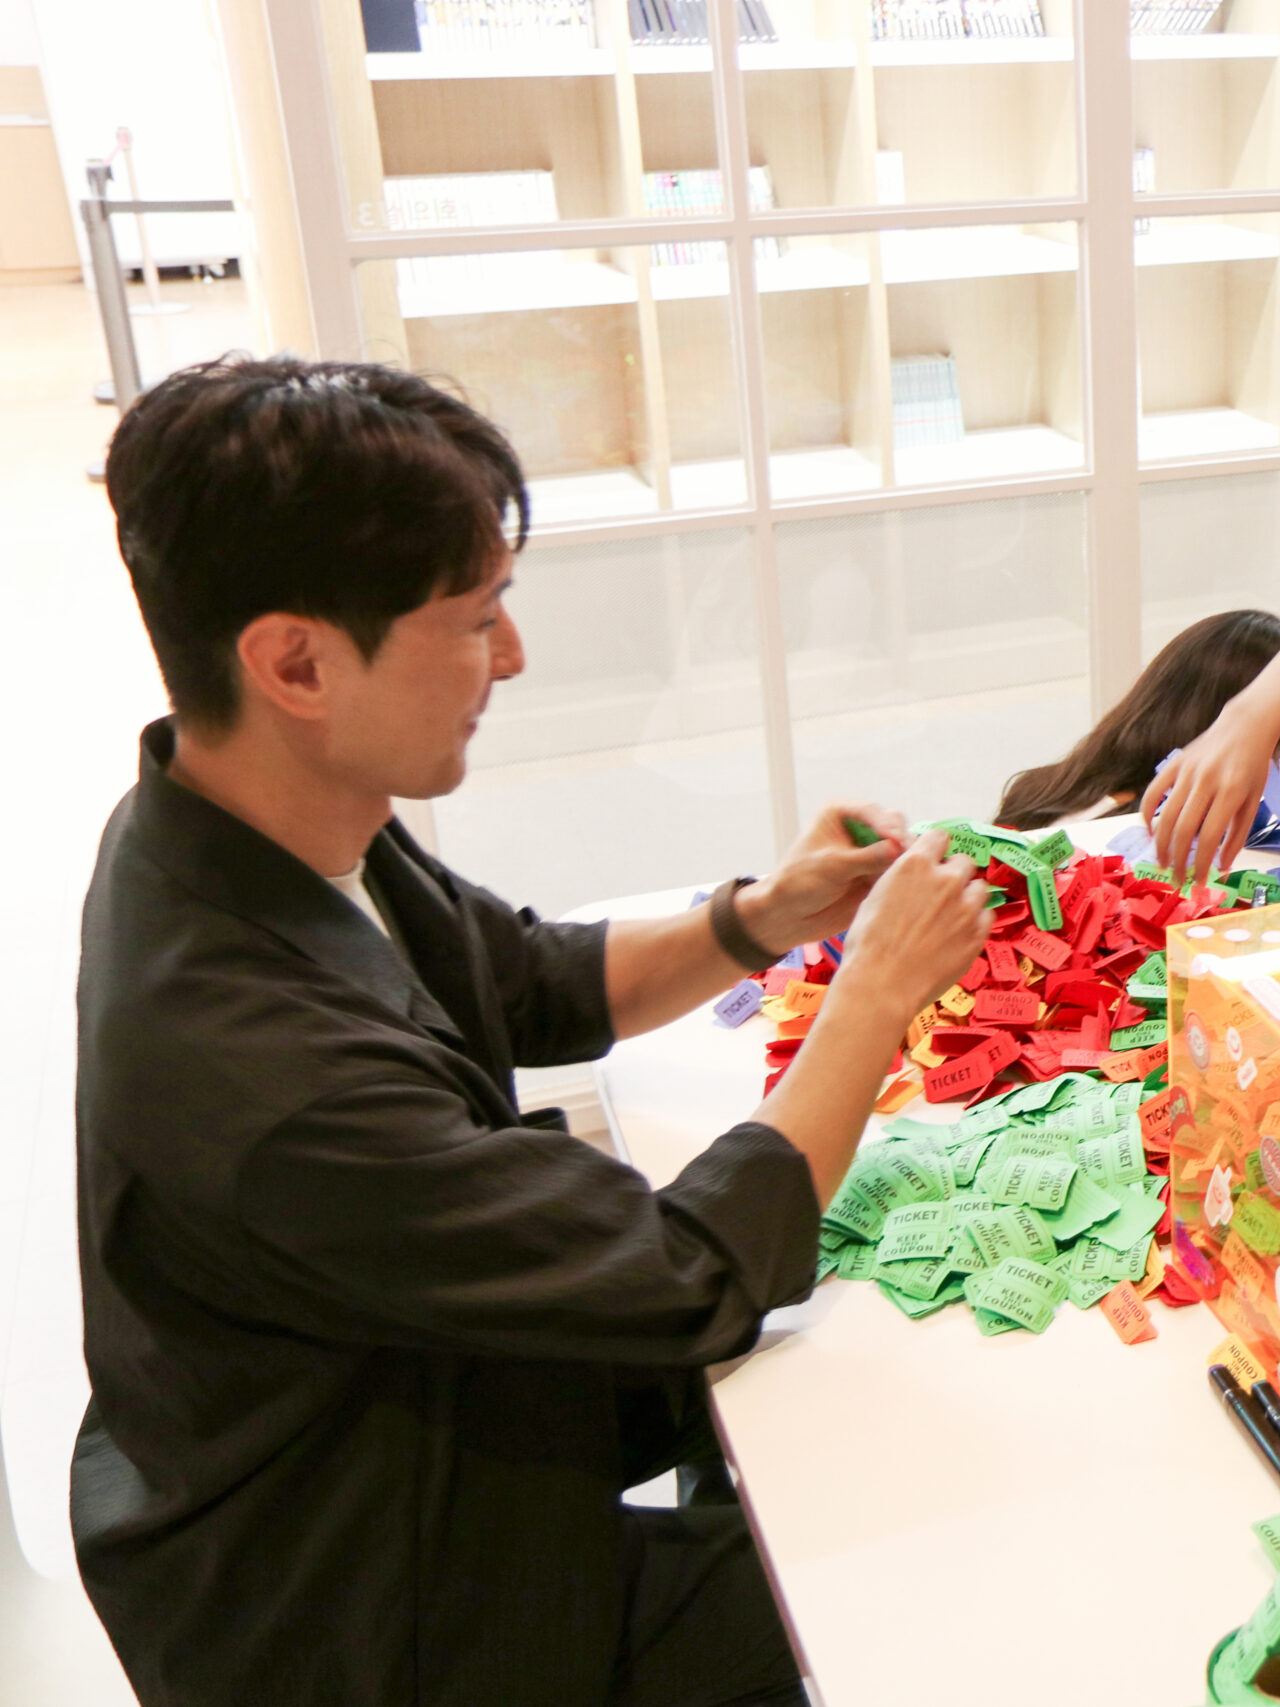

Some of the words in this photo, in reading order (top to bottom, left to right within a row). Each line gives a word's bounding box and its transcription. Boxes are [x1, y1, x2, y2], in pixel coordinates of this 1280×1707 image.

[1022, 931, 1056, 957] TICKET
[722, 990, 754, 1019] TICKET
[989, 993, 1033, 1005] COUPON
[1124, 1023, 1166, 1035] COUPON
[931, 1067, 972, 1092] TICKET
[1020, 1132, 1070, 1142] COUPON
[1117, 1134, 1134, 1169] TICKET
[874, 1176, 898, 1199] KEEP
[890, 1159, 928, 1193] TICKET
[1004, 1163, 1027, 1198] TICKET
[1036, 1169, 1051, 1193] KEEP
[841, 1197, 872, 1213] KEEP
[855, 1177, 891, 1214] COUPON
[954, 1200, 998, 1213] TICKET
[830, 1206, 871, 1229] OUPON
[893, 1210, 940, 1226] TICKET
[1013, 1208, 1043, 1248] TICKET
[896, 1232, 928, 1244] KEEP
[973, 1218, 1001, 1261] COUPON
[991, 1221, 1012, 1249] KEEP
[883, 1244, 935, 1257] COUPON
[1081, 1236, 1102, 1272] TICKE
[1127, 1238, 1145, 1273] COUPO
[1004, 1263, 1054, 1290] TICKET
[983, 1294, 1035, 1322] COUPON
[1000, 1286, 1033, 1304] KEEP
[1119, 1288, 1146, 1323] COUPON
[1228, 1344, 1259, 1380] COUPON
